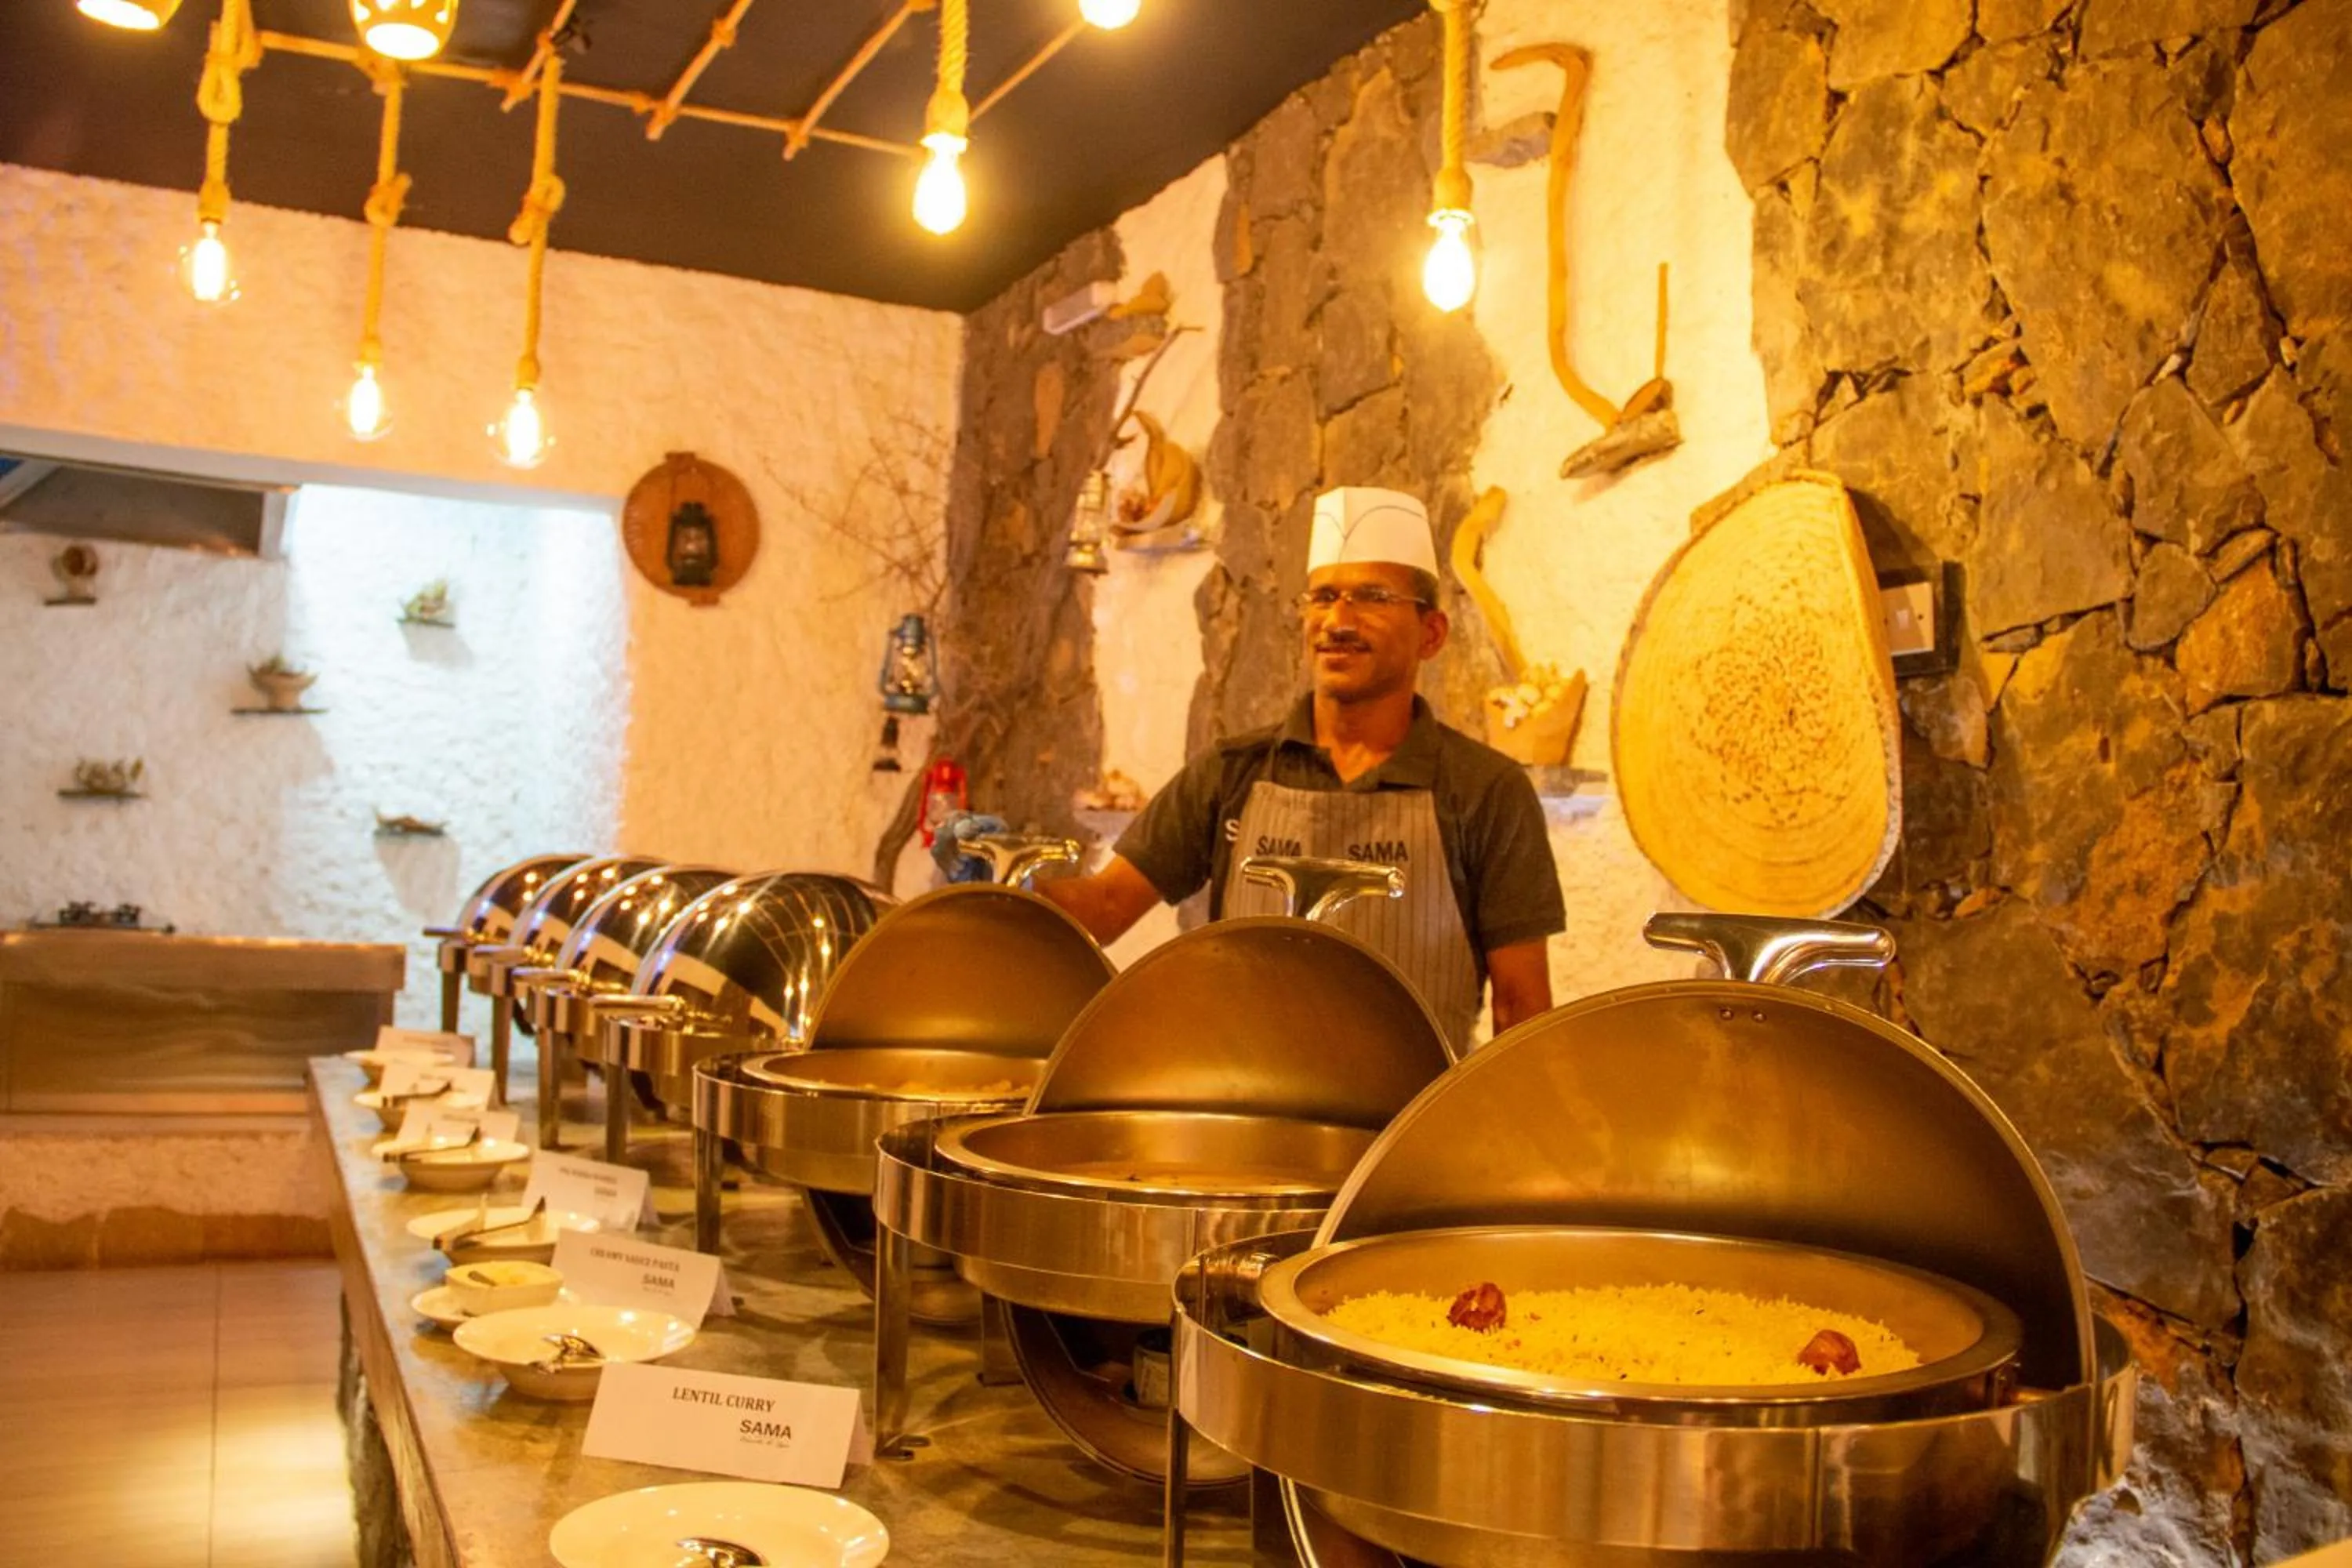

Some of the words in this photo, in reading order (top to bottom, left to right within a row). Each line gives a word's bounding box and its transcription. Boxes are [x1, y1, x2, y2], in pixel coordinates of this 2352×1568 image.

[1256, 835, 1302, 857] SAMA
[1348, 840, 1408, 862] SAMA
[643, 1272, 674, 1289] SAMA
[672, 1386, 722, 1406] LENTIL
[726, 1394, 776, 1412] CURRY
[739, 1419, 791, 1439] SAMA
